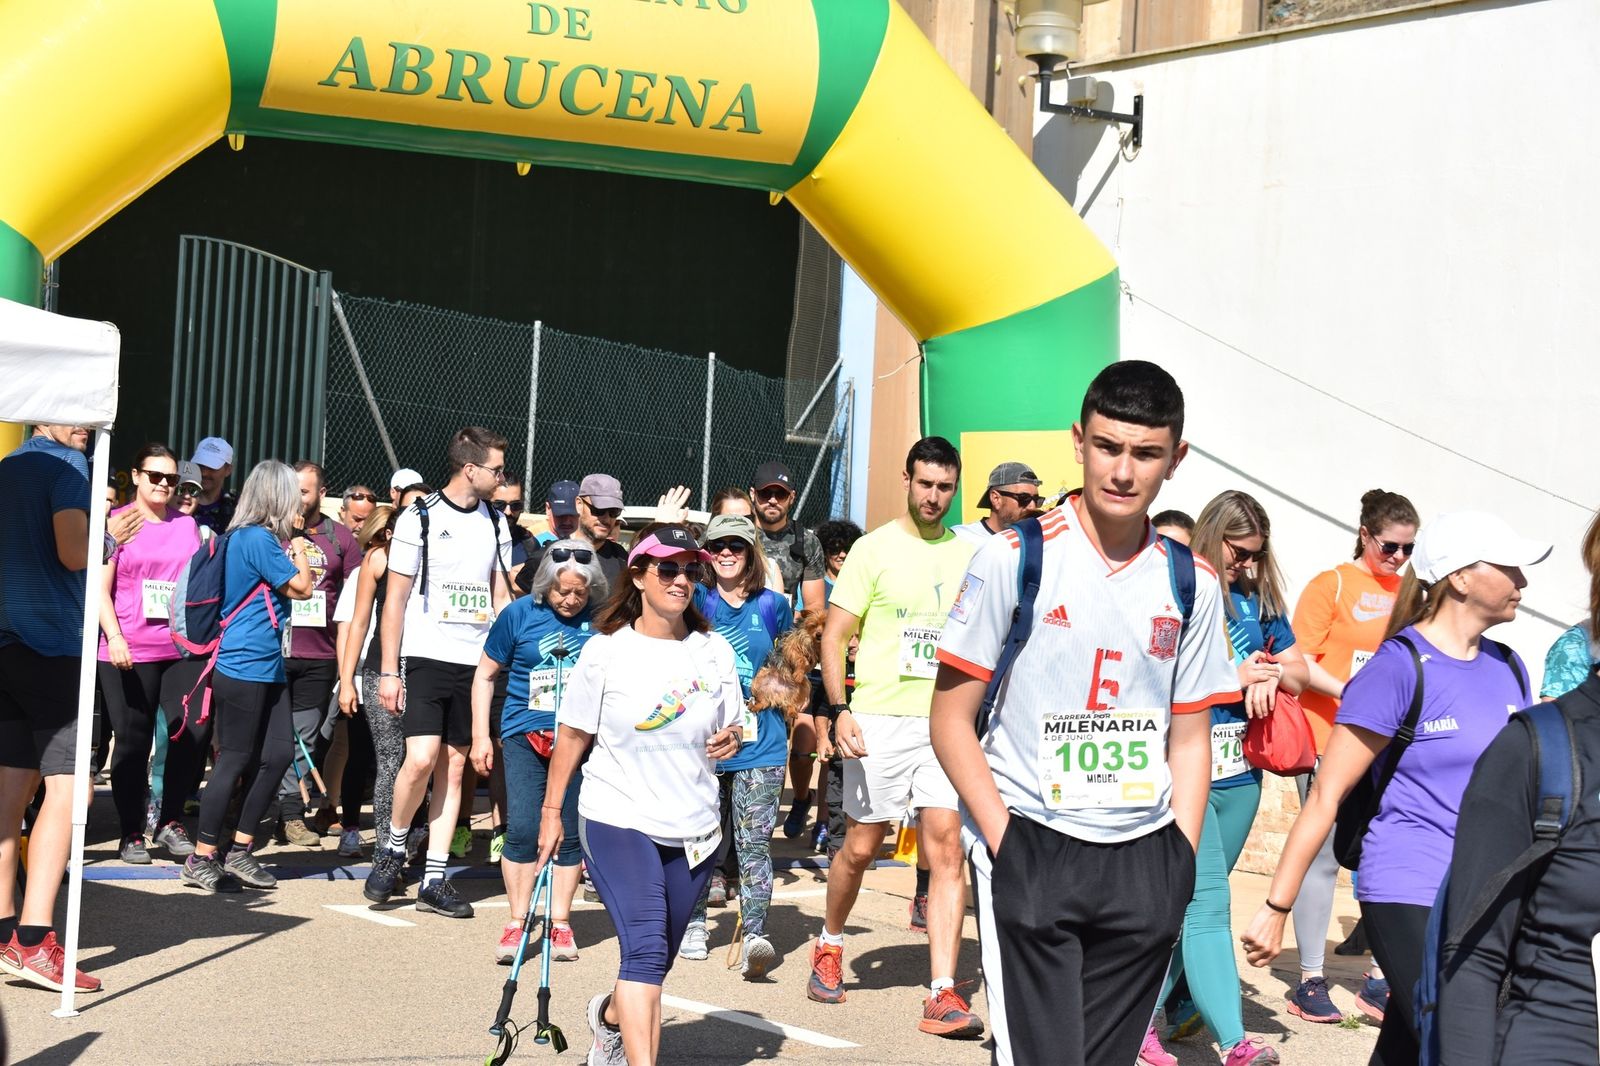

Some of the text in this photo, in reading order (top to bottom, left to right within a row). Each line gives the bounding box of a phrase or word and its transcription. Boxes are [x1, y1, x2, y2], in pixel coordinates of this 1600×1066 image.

[527, 2, 593, 41] DE
[318, 36, 762, 134] ABRUCENA
[442, 584, 489, 593] MILENARIA
[449, 592, 487, 608] 1018
[1042, 617, 1072, 628] adidas
[1044, 719, 1158, 734] MILENARIA
[1423, 715, 1460, 733] MARÍA
[1055, 741, 1149, 772] 1035
[1086, 773, 1119, 783] MIGUEL
